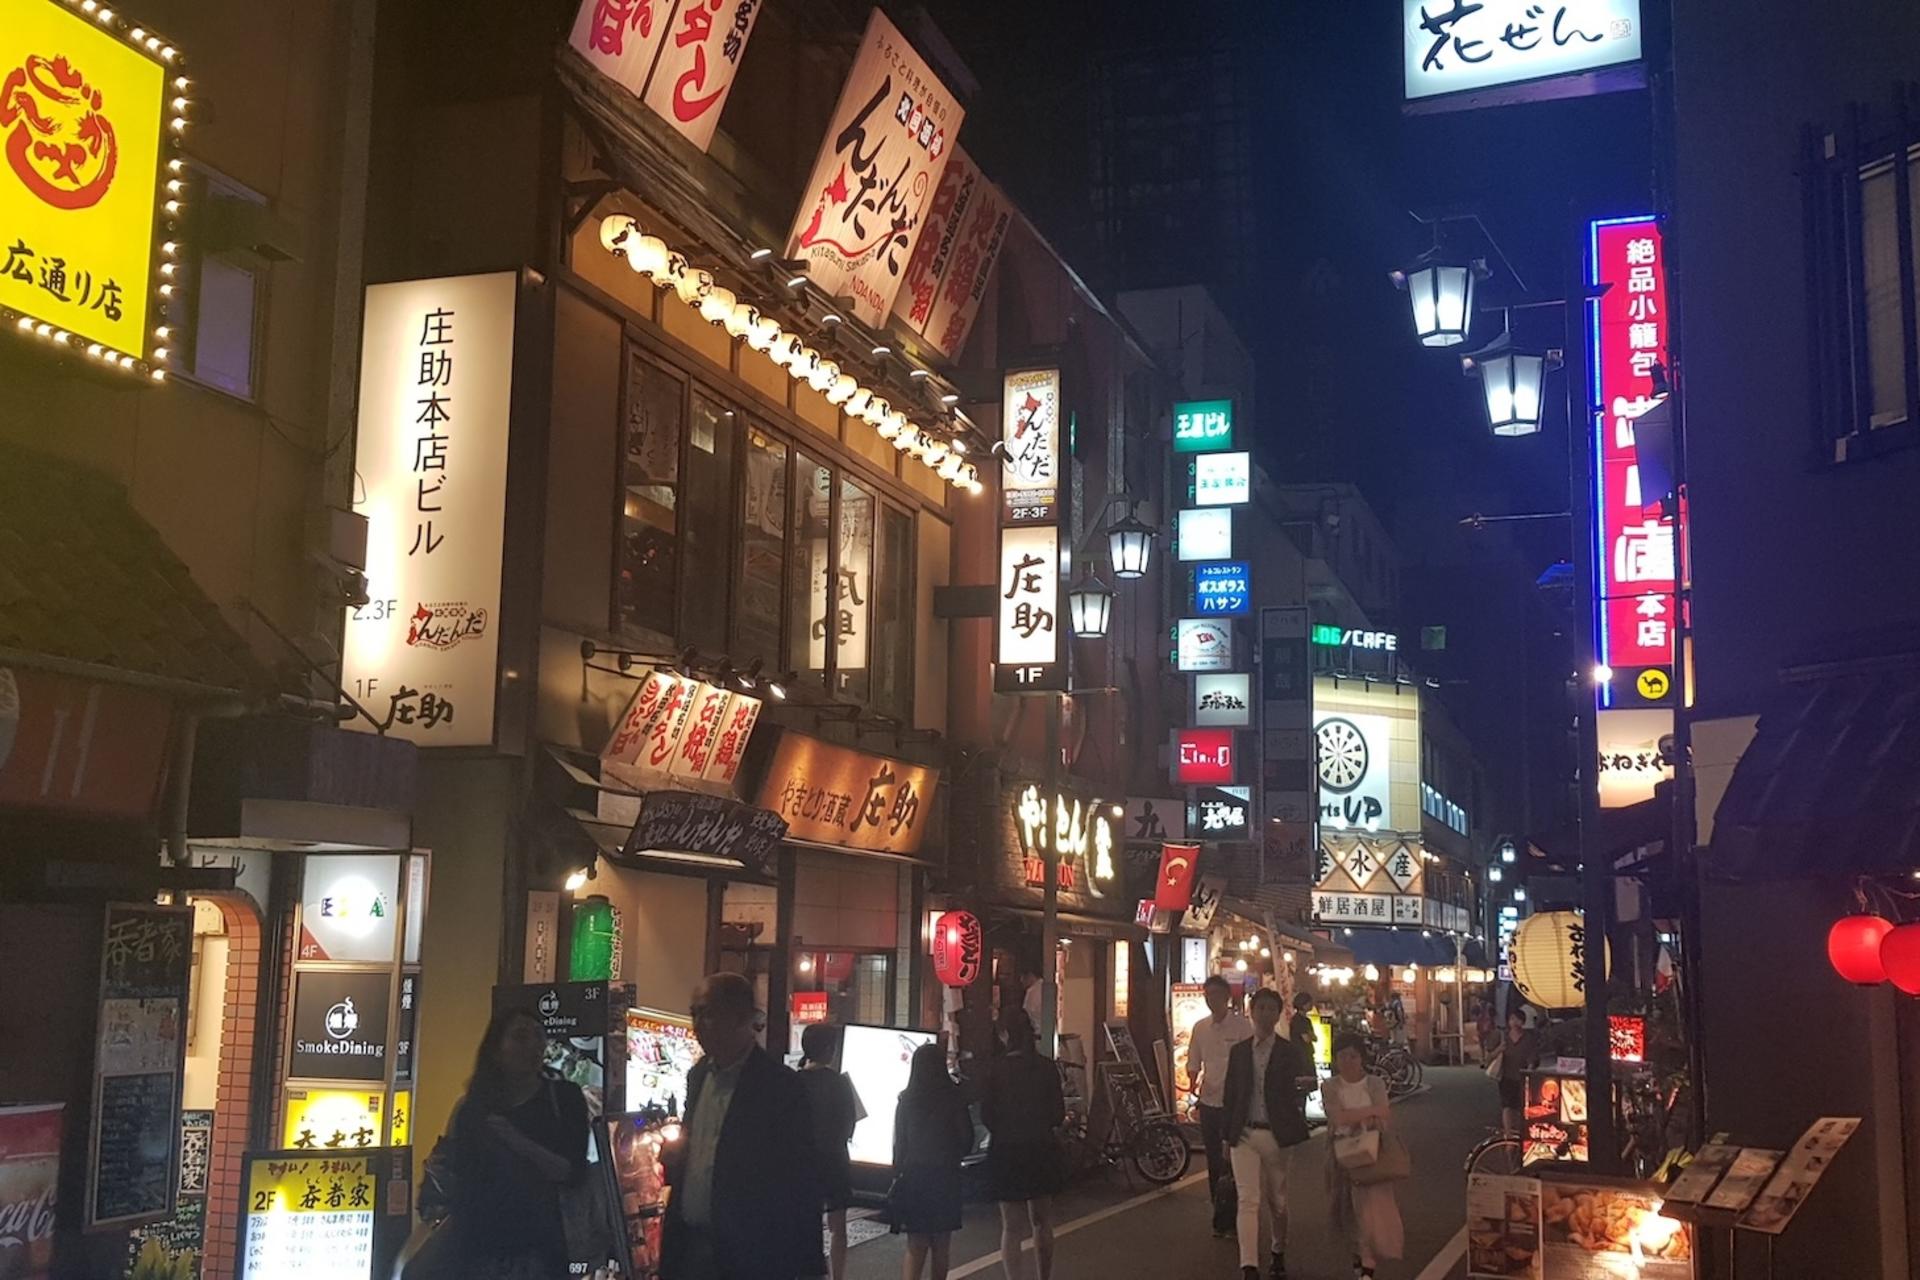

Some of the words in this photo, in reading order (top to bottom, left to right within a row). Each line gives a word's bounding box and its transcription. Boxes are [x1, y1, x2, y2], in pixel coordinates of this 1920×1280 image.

[835, 75, 918, 277] んだんだ
[0, 239, 124, 322] 広通り店
[850, 276, 886, 314] NDANDA
[1626, 238, 1658, 378] 絶品小籠包
[408, 306, 456, 558] 庄助本店ビル
[1018, 405, 1051, 478] んだんだ
[1005, 551, 1054, 640] 庄助
[1203, 596, 1242, 611] ハサン
[1635, 590, 1667, 649] 本店
[355, 678, 379, 699] 1F
[1015, 666, 1043, 683] 1F
[382, 684, 455, 730] 庄助
[779, 779, 852, 828] やきとり酒蔵
[850, 762, 919, 837] 庄助
[1343, 795, 1383, 826] UP
[1312, 895, 1386, 918] 鮮居酒屋
[300, 944, 319, 958] 4F
[584, 987, 601, 1000] 3F
[296, 1039, 385, 1058] SmokeDining
[254, 1190, 276, 1211] 2F
[299, 1182, 372, 1210] 呑者家
[568, 1262, 589, 1274] 697
